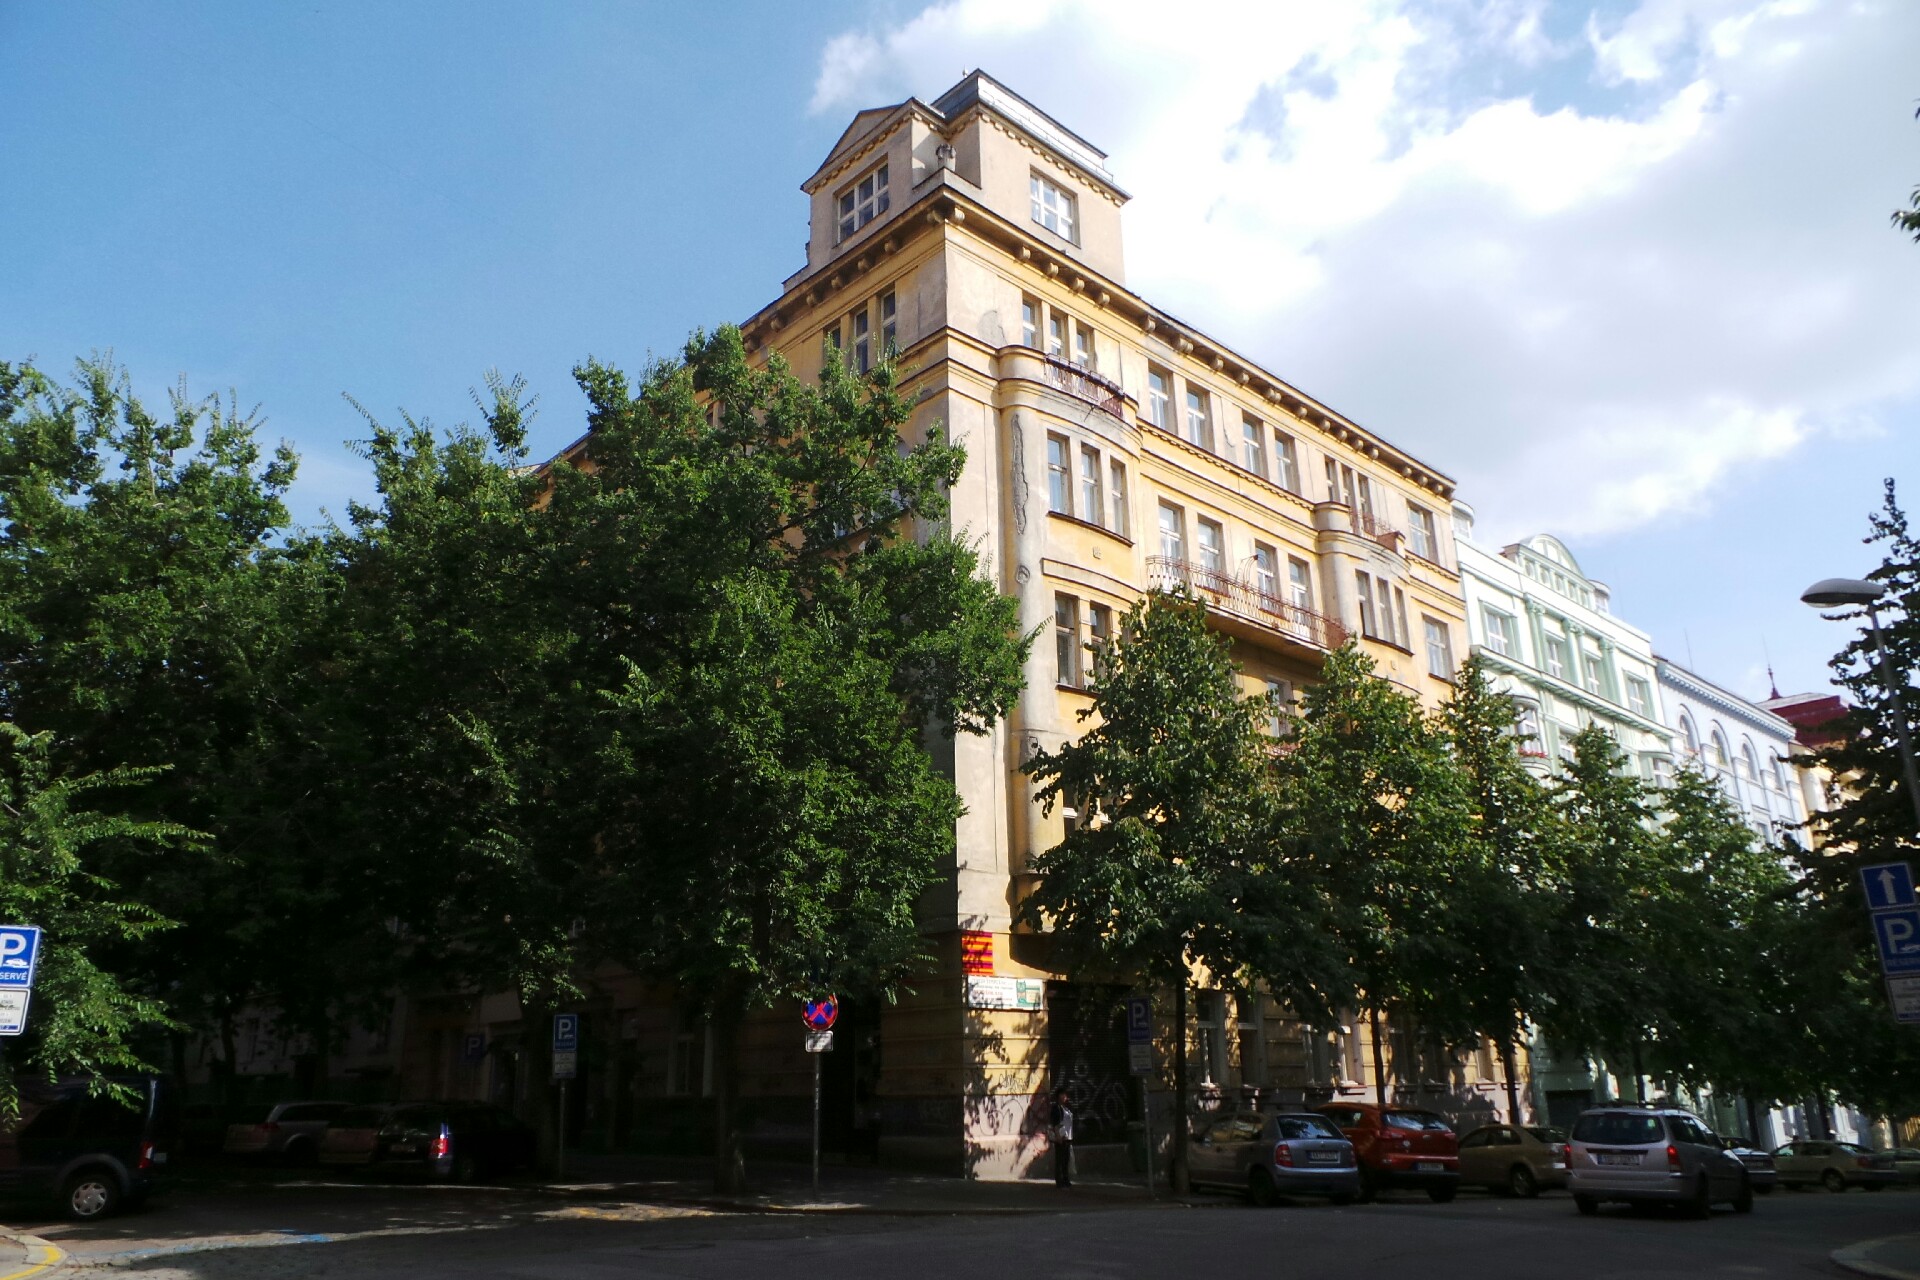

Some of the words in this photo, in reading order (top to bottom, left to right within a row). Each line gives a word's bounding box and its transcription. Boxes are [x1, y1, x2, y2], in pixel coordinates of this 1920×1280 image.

[1883, 918, 1914, 954] P
[0, 932, 27, 967] P
[1133, 1002, 1146, 1027] P
[559, 1019, 572, 1039] P
[468, 1037, 481, 1055] P
